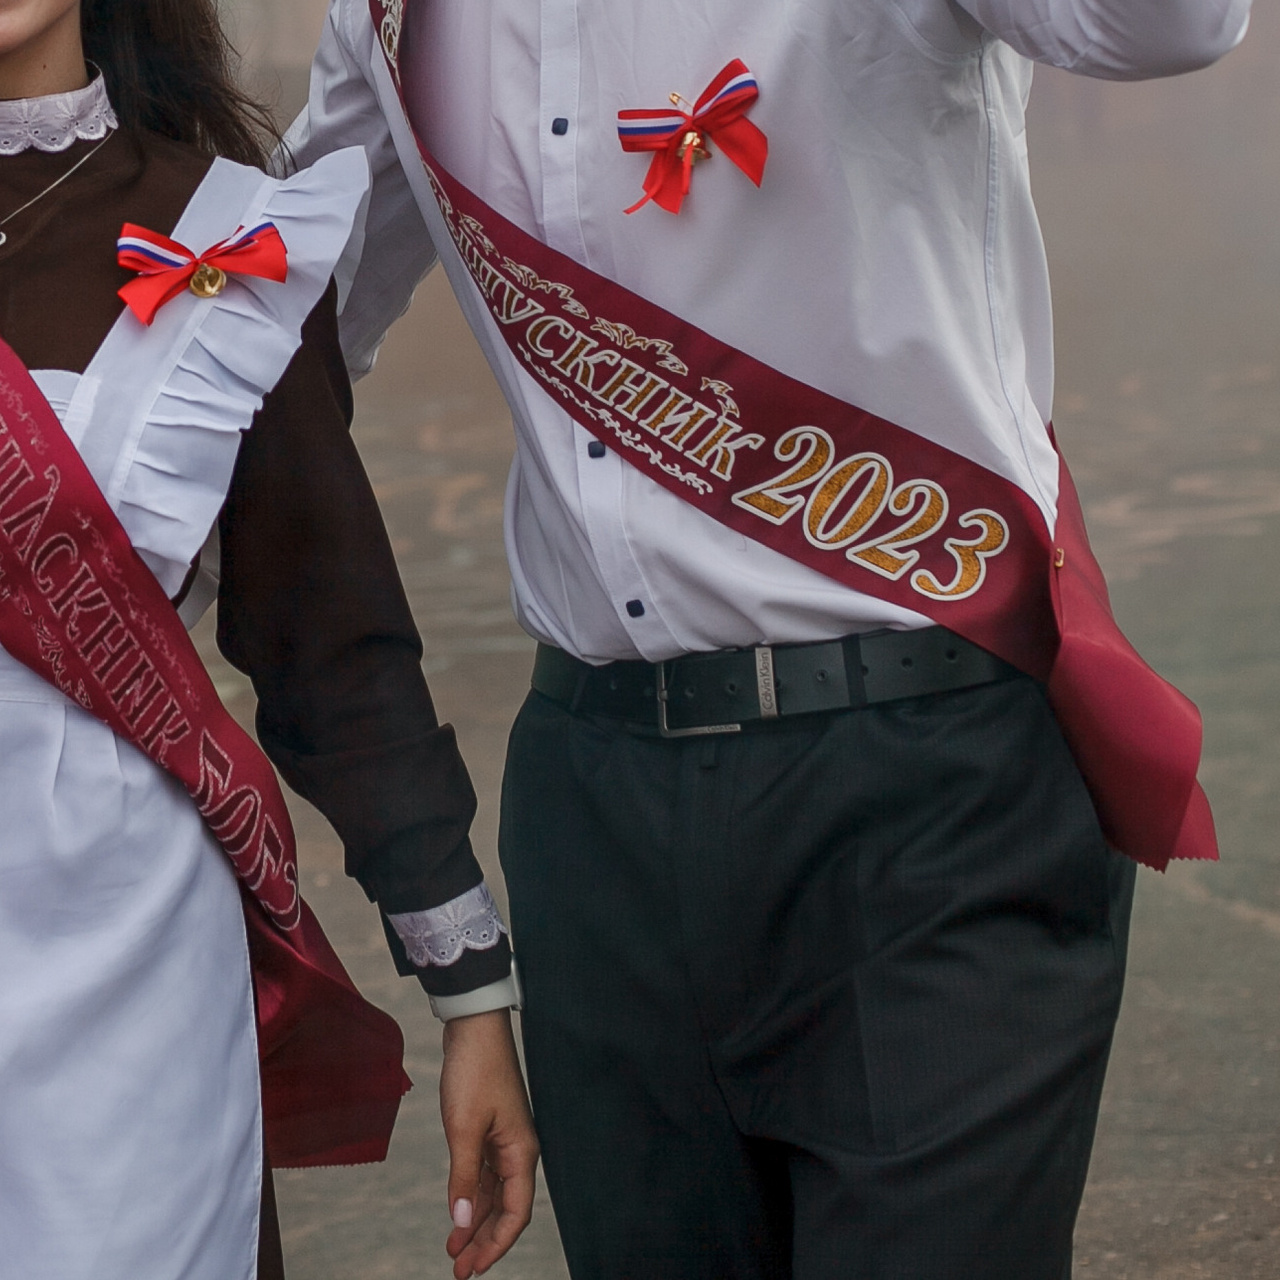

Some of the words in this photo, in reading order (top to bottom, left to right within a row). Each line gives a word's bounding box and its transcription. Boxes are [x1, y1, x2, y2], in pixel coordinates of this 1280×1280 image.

[732, 425, 1011, 600] 2023
[759, 652, 770, 677] Klein
[761, 677, 774, 710] Calvin
